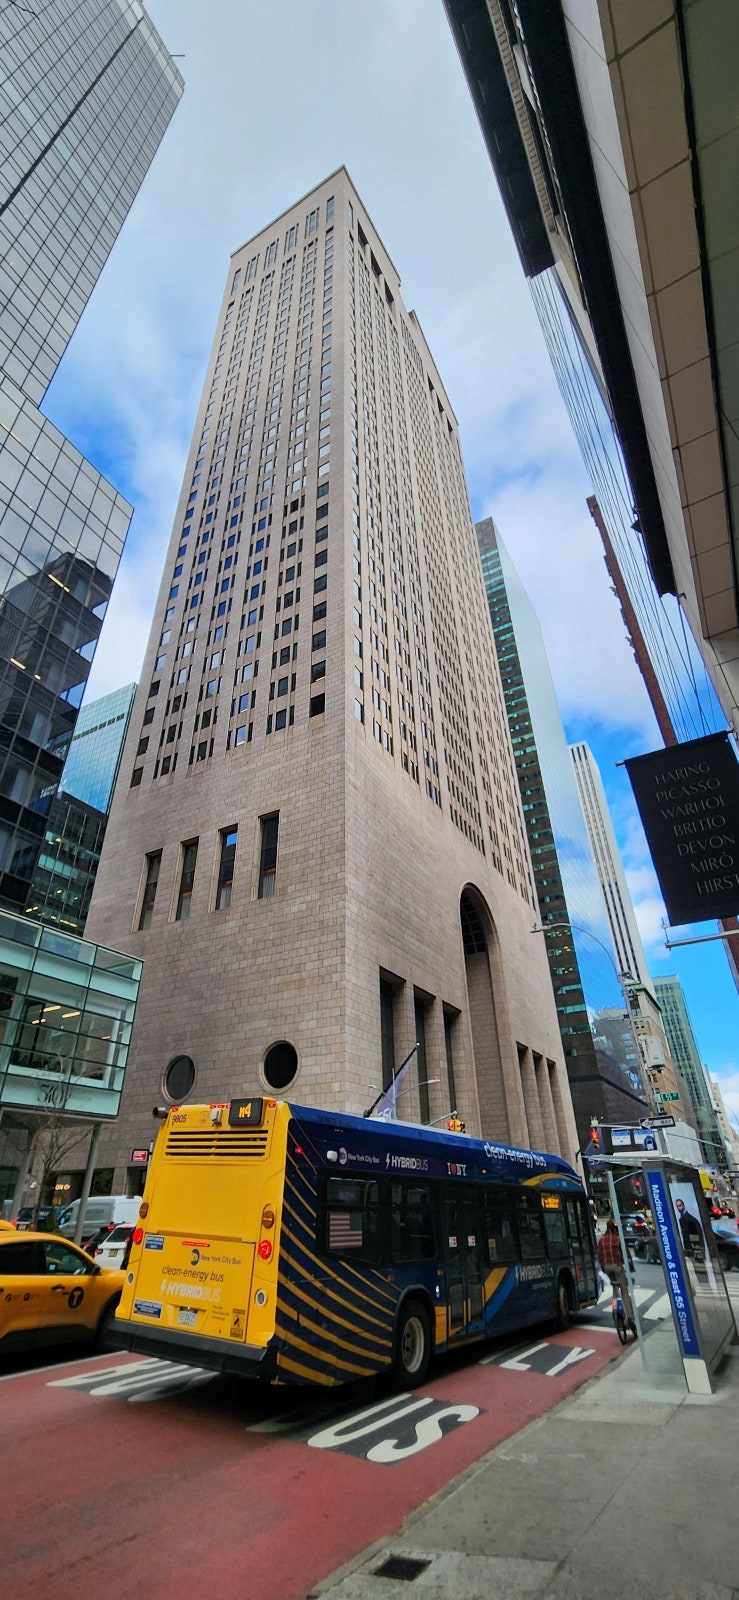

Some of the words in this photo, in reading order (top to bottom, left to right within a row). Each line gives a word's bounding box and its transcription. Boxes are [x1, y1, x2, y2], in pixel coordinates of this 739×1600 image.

[654, 762, 710, 786] HARING
[655, 777, 720, 803] PICASSO
[661, 795, 727, 820] WARHOL
[673, 815, 726, 837] BRITTO
[677, 833, 736, 856] DEVON
[691, 851, 734, 874] MIRÓ
[484, 1142, 534, 1168] clean-energy
[534, 1152, 547, 1167] bus
[651, 1184, 665, 1223] Madison
[660, 1224, 672, 1260] Avenue
[211, 1255, 222, 1263] York
[223, 1257, 233, 1265] City
[668, 1261, 676, 1269] &
[162, 1265, 209, 1283] clean-energy
[210, 1271, 224, 1282] bus
[670, 1271, 681, 1294] East
[675, 1296, 685, 1309] 55
[679, 1311, 691, 1343] Street
[478, 1342, 596, 1376] LY
